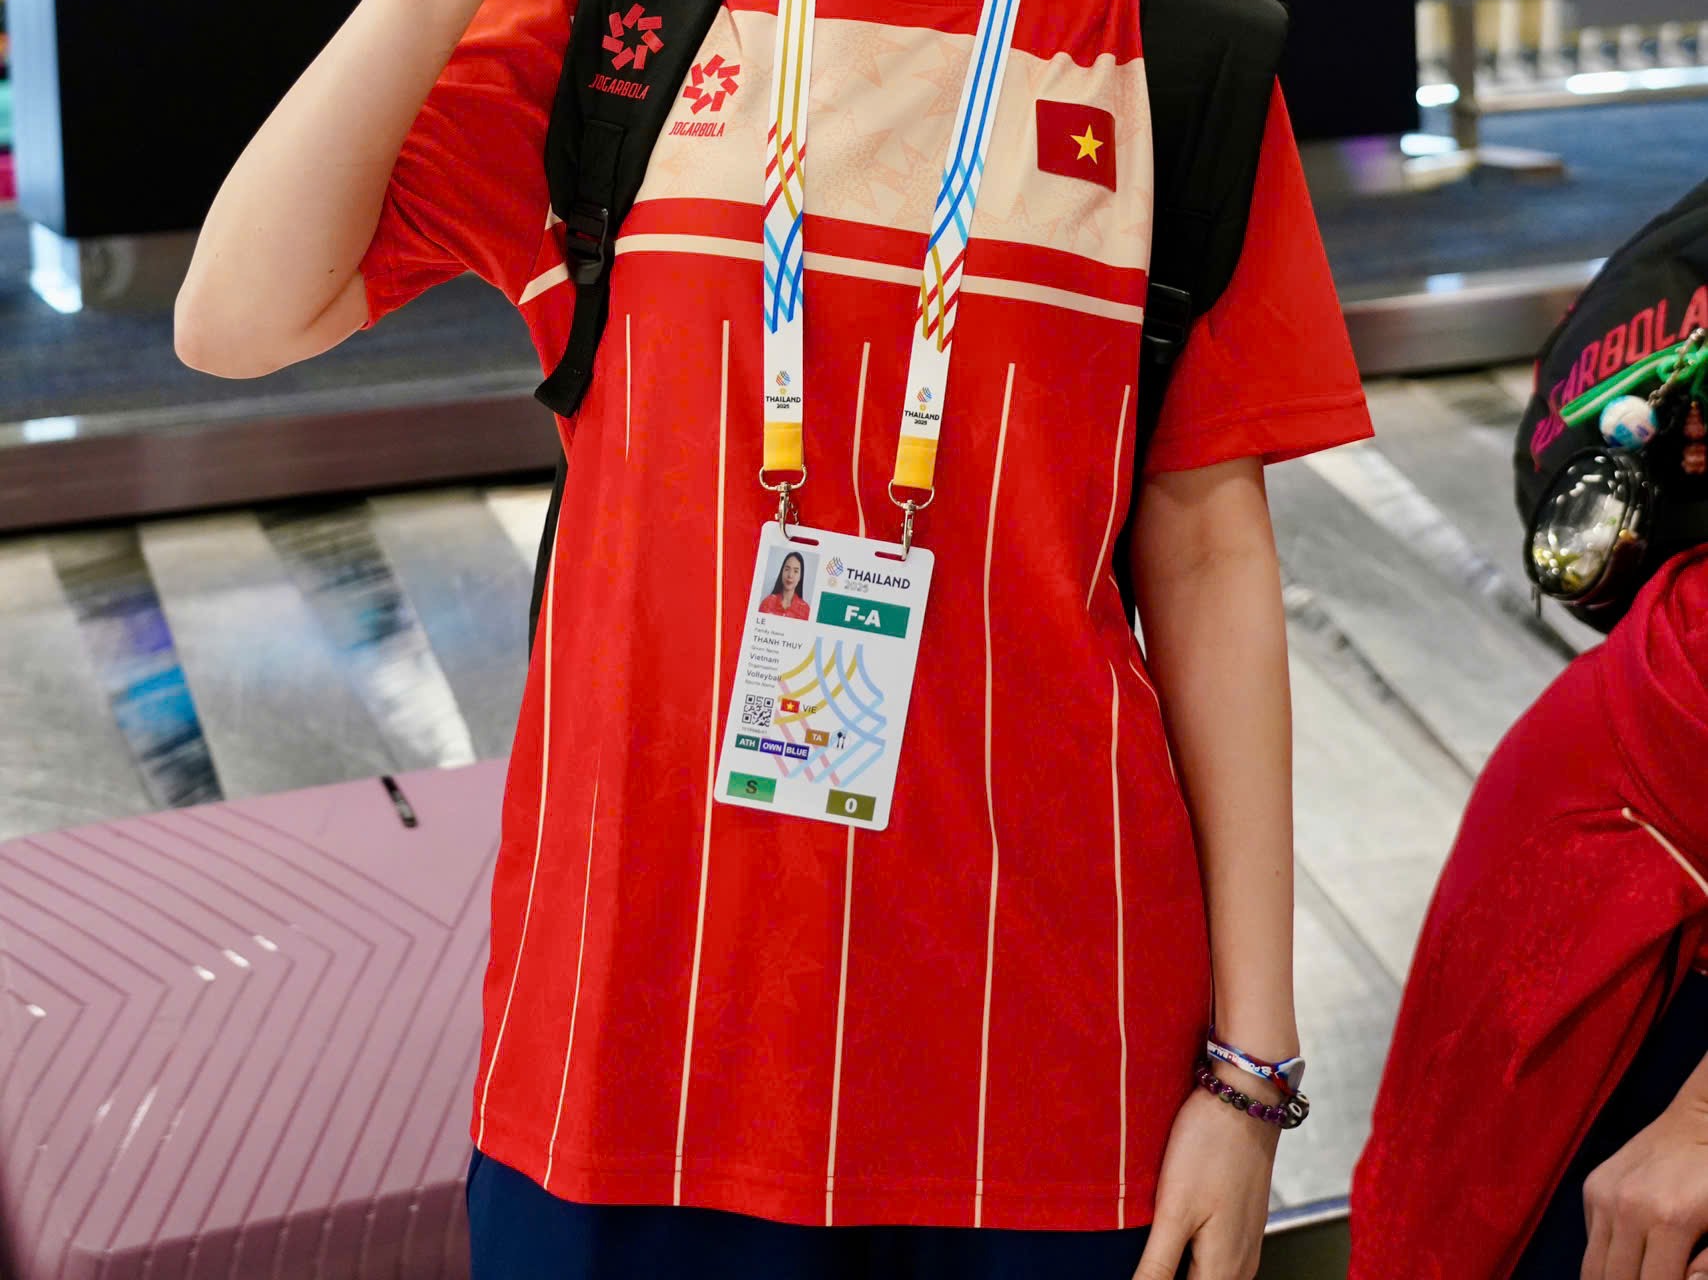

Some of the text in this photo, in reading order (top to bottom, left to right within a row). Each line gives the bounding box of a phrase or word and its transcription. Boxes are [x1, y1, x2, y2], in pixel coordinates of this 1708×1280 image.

[588, 73, 650, 101] JOGARBOLA
[668, 121, 725, 137] JOGARBOLA
[765, 395, 802, 403] THAILAND
[904, 410, 940, 421] THAILAND
[846, 567, 911, 590] THAILAND
[756, 617, 766, 625] LE
[844, 604, 881, 628] F-A
[753, 635, 803, 650] THANH THUY
[749, 653, 780, 664] Vietnam
[747, 670, 782, 681] Volleyball
[803, 704, 817, 714] VIE
[739, 738, 757, 747] ATH
[812, 733, 823, 742] TA
[762, 742, 782, 752] OWN
[786, 746, 809, 757] BLUE
[745, 780, 758, 794] S
